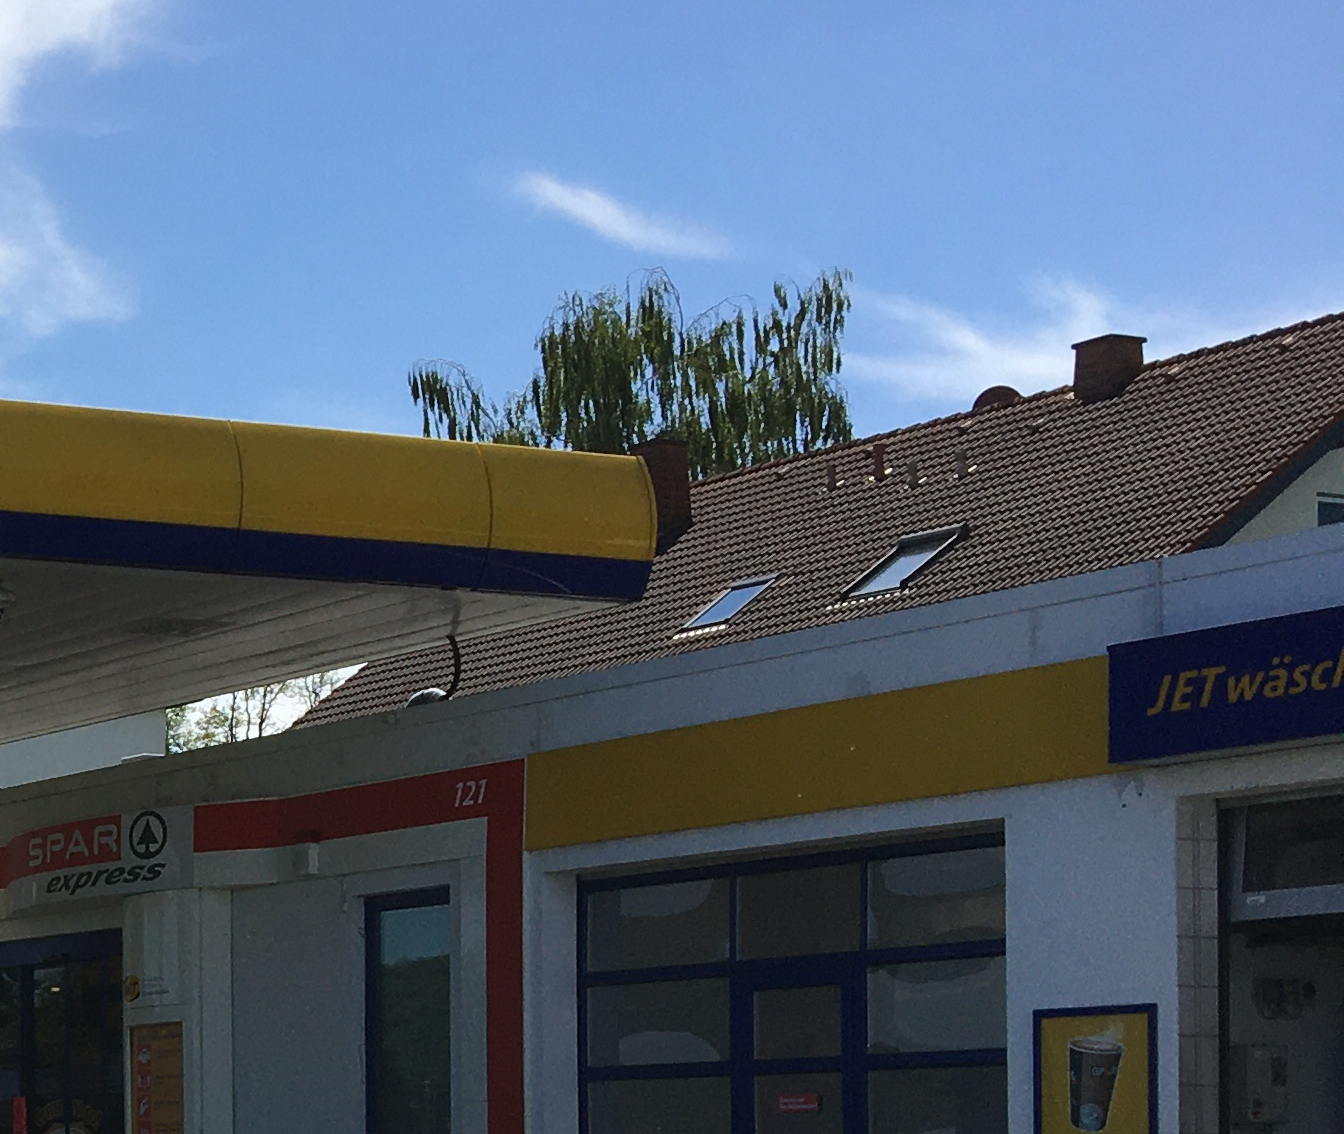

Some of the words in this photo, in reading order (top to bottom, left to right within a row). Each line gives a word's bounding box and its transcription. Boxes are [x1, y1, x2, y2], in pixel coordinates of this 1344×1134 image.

[1146, 665, 1226, 716] JET
[454, 779, 487, 807] 121
[28, 824, 118, 867] SPAR
[46, 862, 166, 896] express
